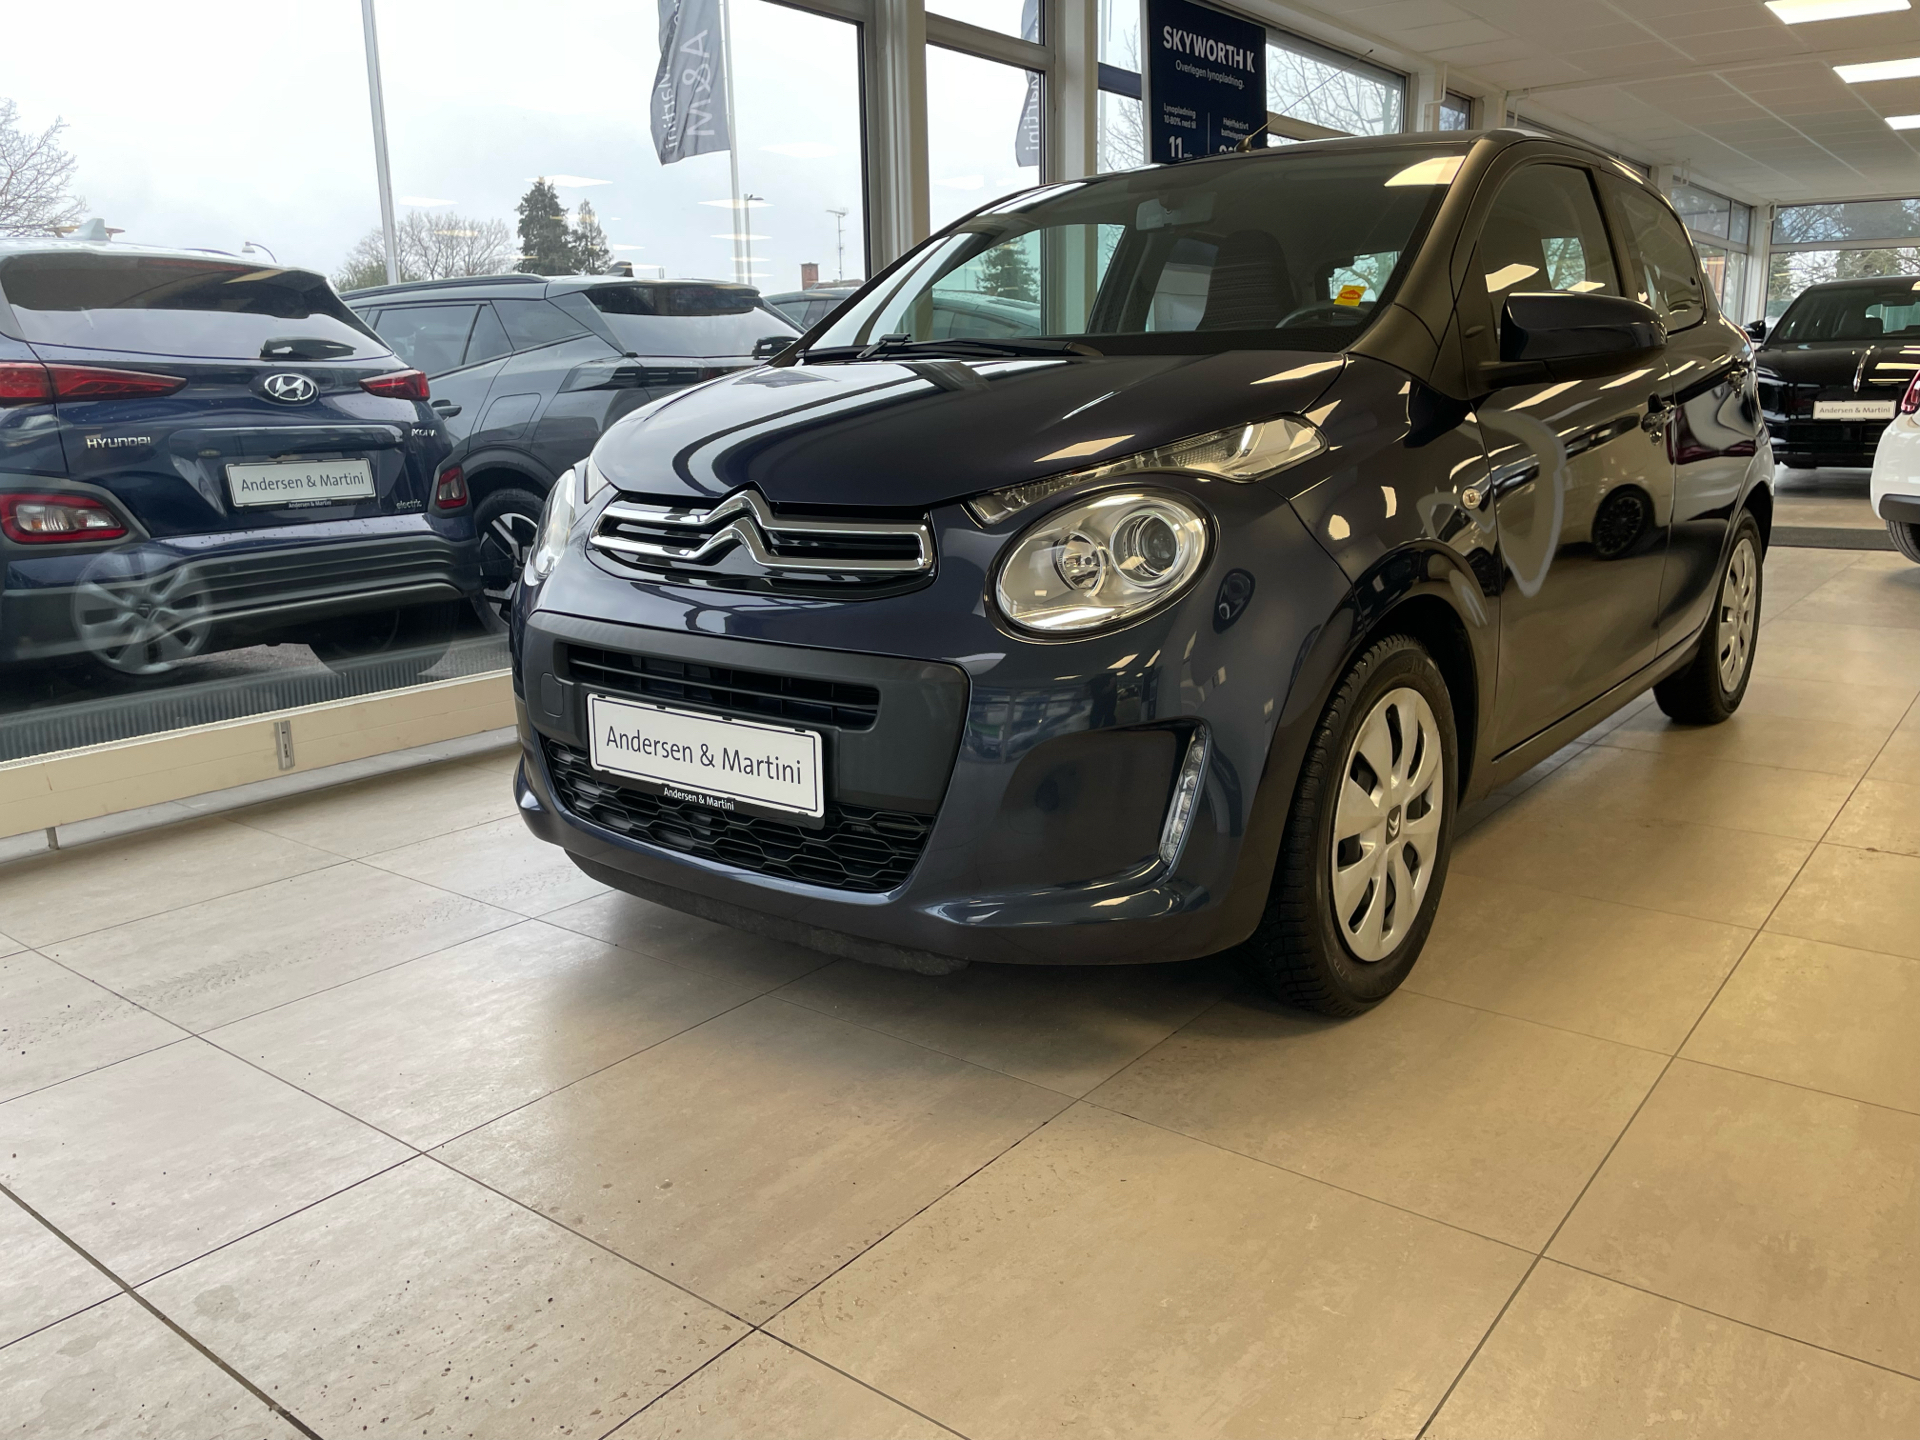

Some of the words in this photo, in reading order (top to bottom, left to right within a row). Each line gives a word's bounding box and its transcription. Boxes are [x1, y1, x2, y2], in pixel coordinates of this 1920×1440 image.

[1163, 25, 1243, 70] SKYWORTH
[1246, 50, 1255, 73] K
[1175, 59, 1206, 78] Overlegen
[1207, 68, 1245, 90] lynopladning.
[1168, 135, 1183, 159] 11
[86, 436, 151, 449] HYUNDAI
[241, 476, 303, 492] Andersen
[306, 475, 317, 488] &
[320, 472, 365, 487] Martini
[288, 501, 310, 509] Andersen
[396, 499, 423, 510] electric
[606, 725, 694, 764] Andersen
[699, 743, 716, 769] &
[722, 747, 802, 785] Martini
[663, 786, 697, 803] Andersen
[698, 794, 705, 804] &
[706, 795, 735, 811] Martini
